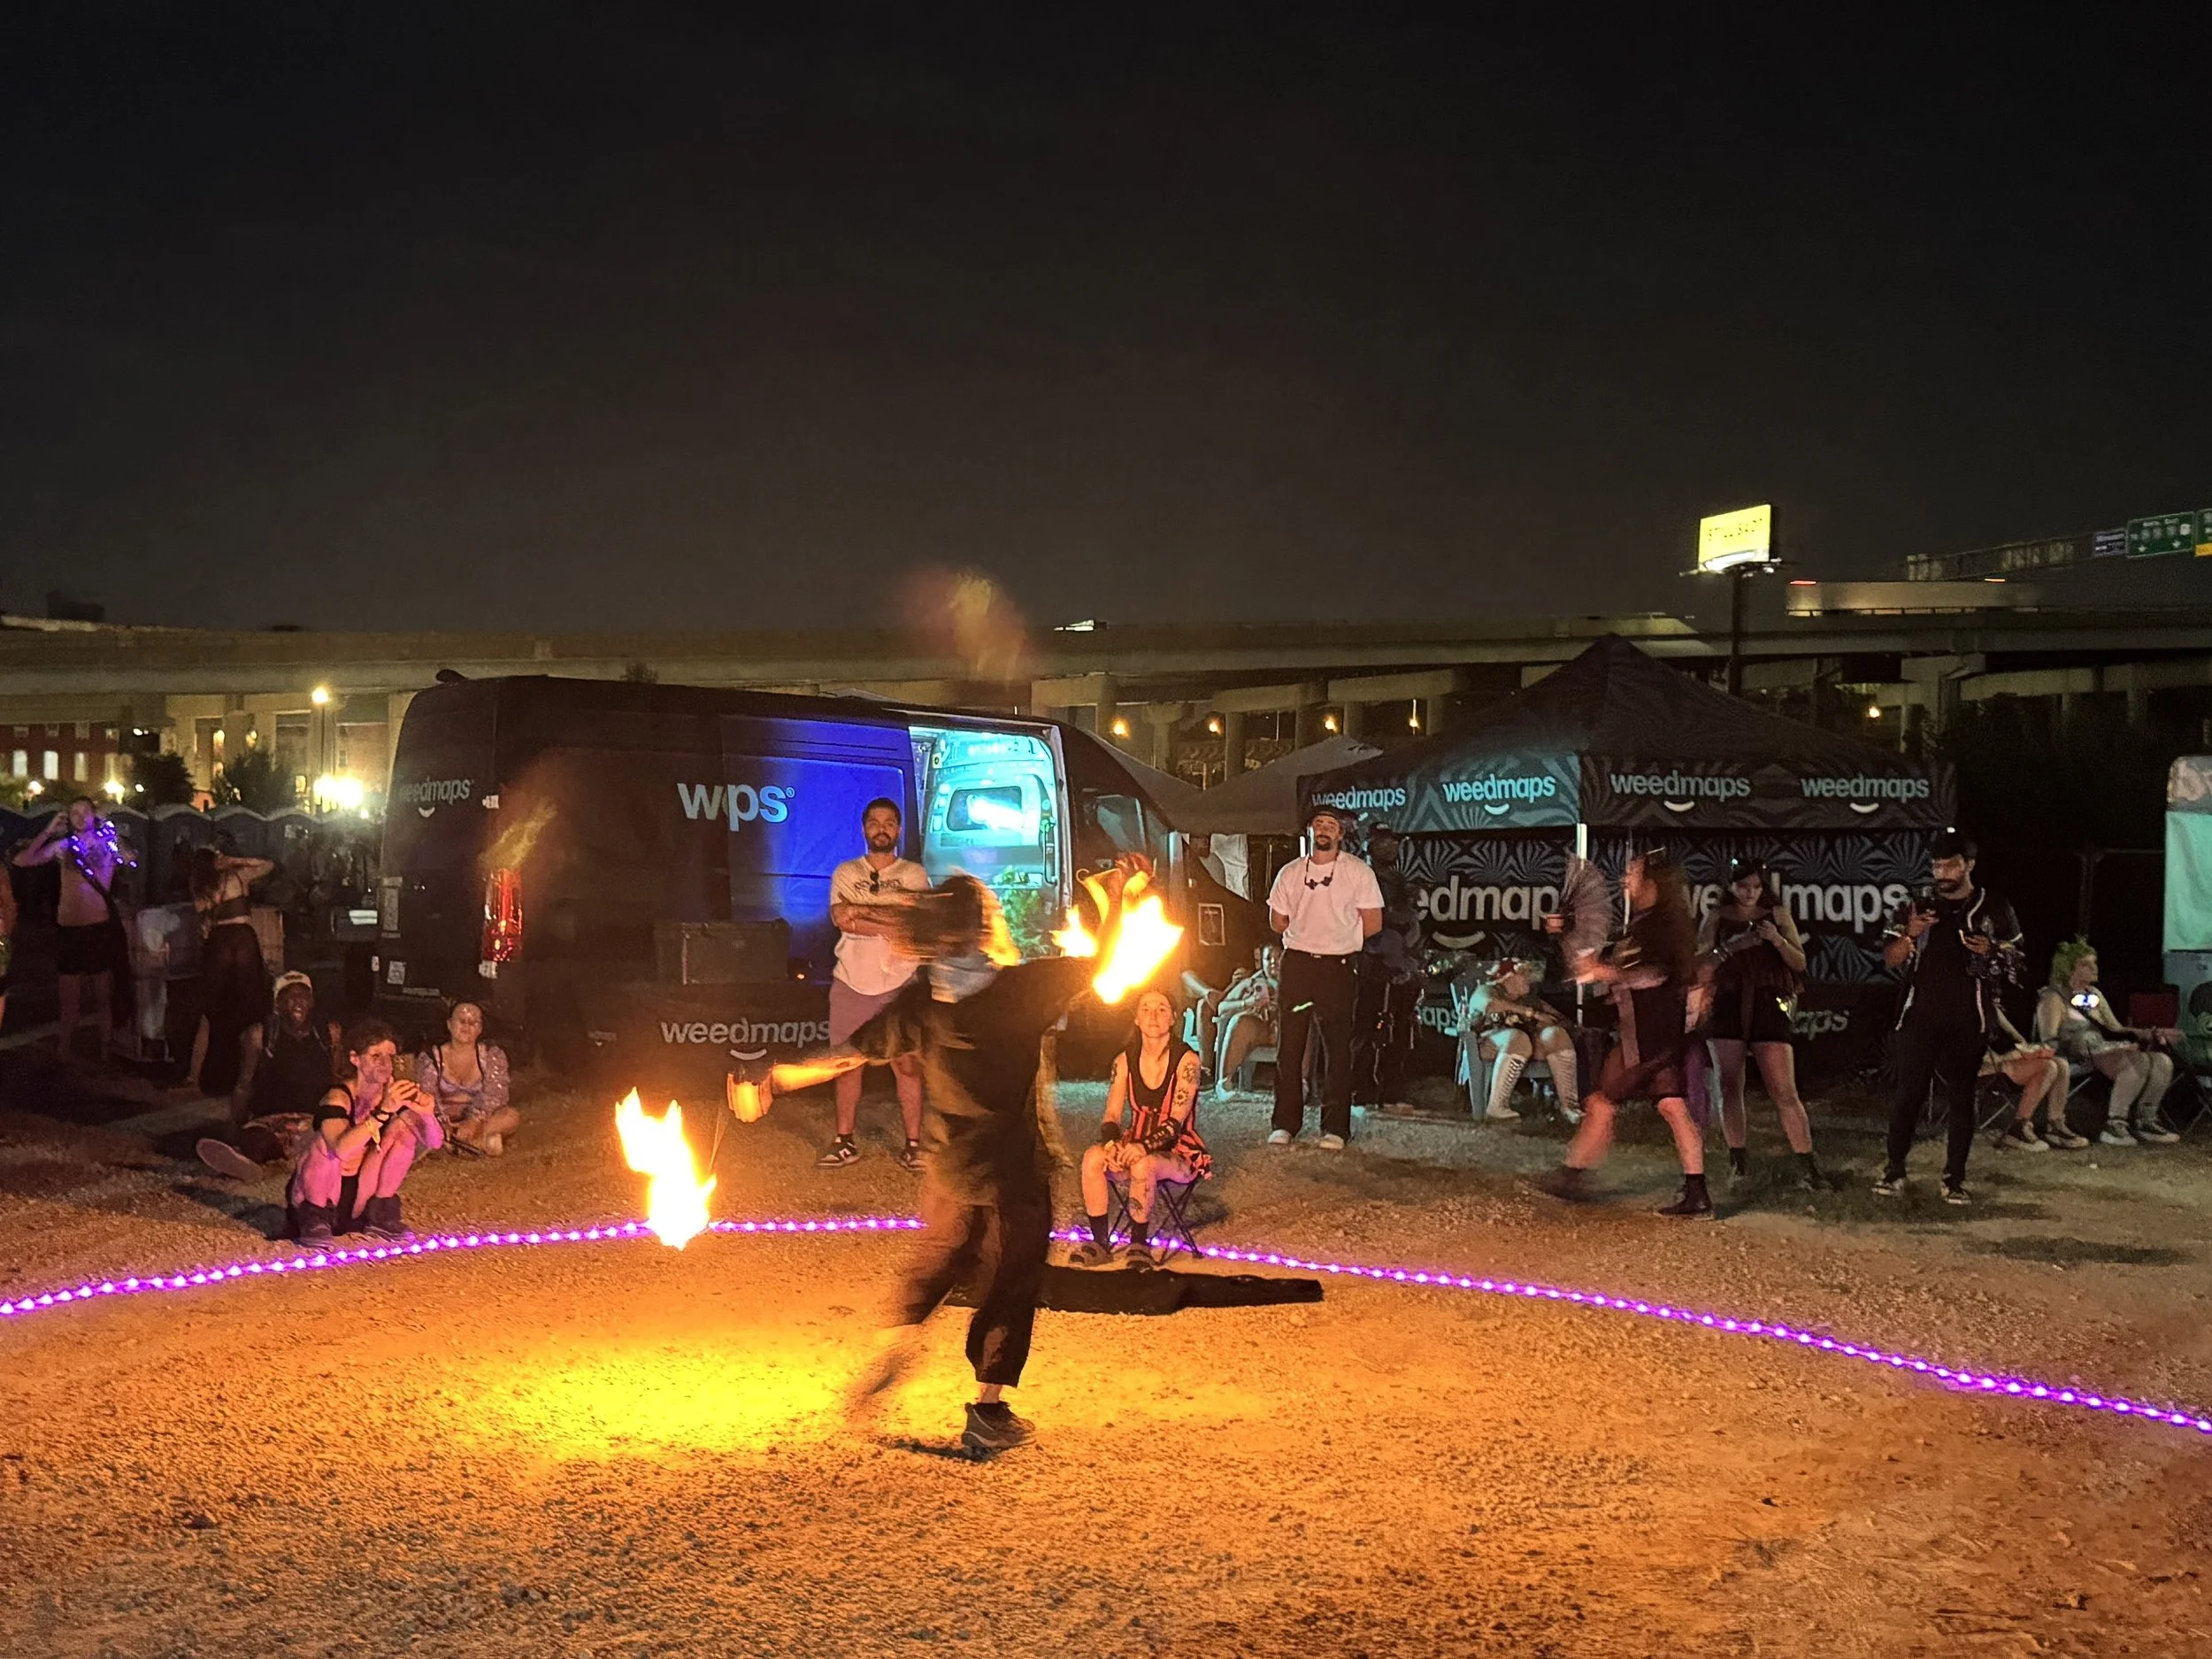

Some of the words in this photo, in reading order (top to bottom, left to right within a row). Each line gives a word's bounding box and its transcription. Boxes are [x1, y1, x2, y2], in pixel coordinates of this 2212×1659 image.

[1312, 786, 1406, 811] weedmaps
[1443, 773, 1556, 803] weedmaps
[1609, 770, 1751, 803] weedmaps
[1801, 773, 1930, 803] weedmaps
[661, 1018, 830, 1048] weedmaps
